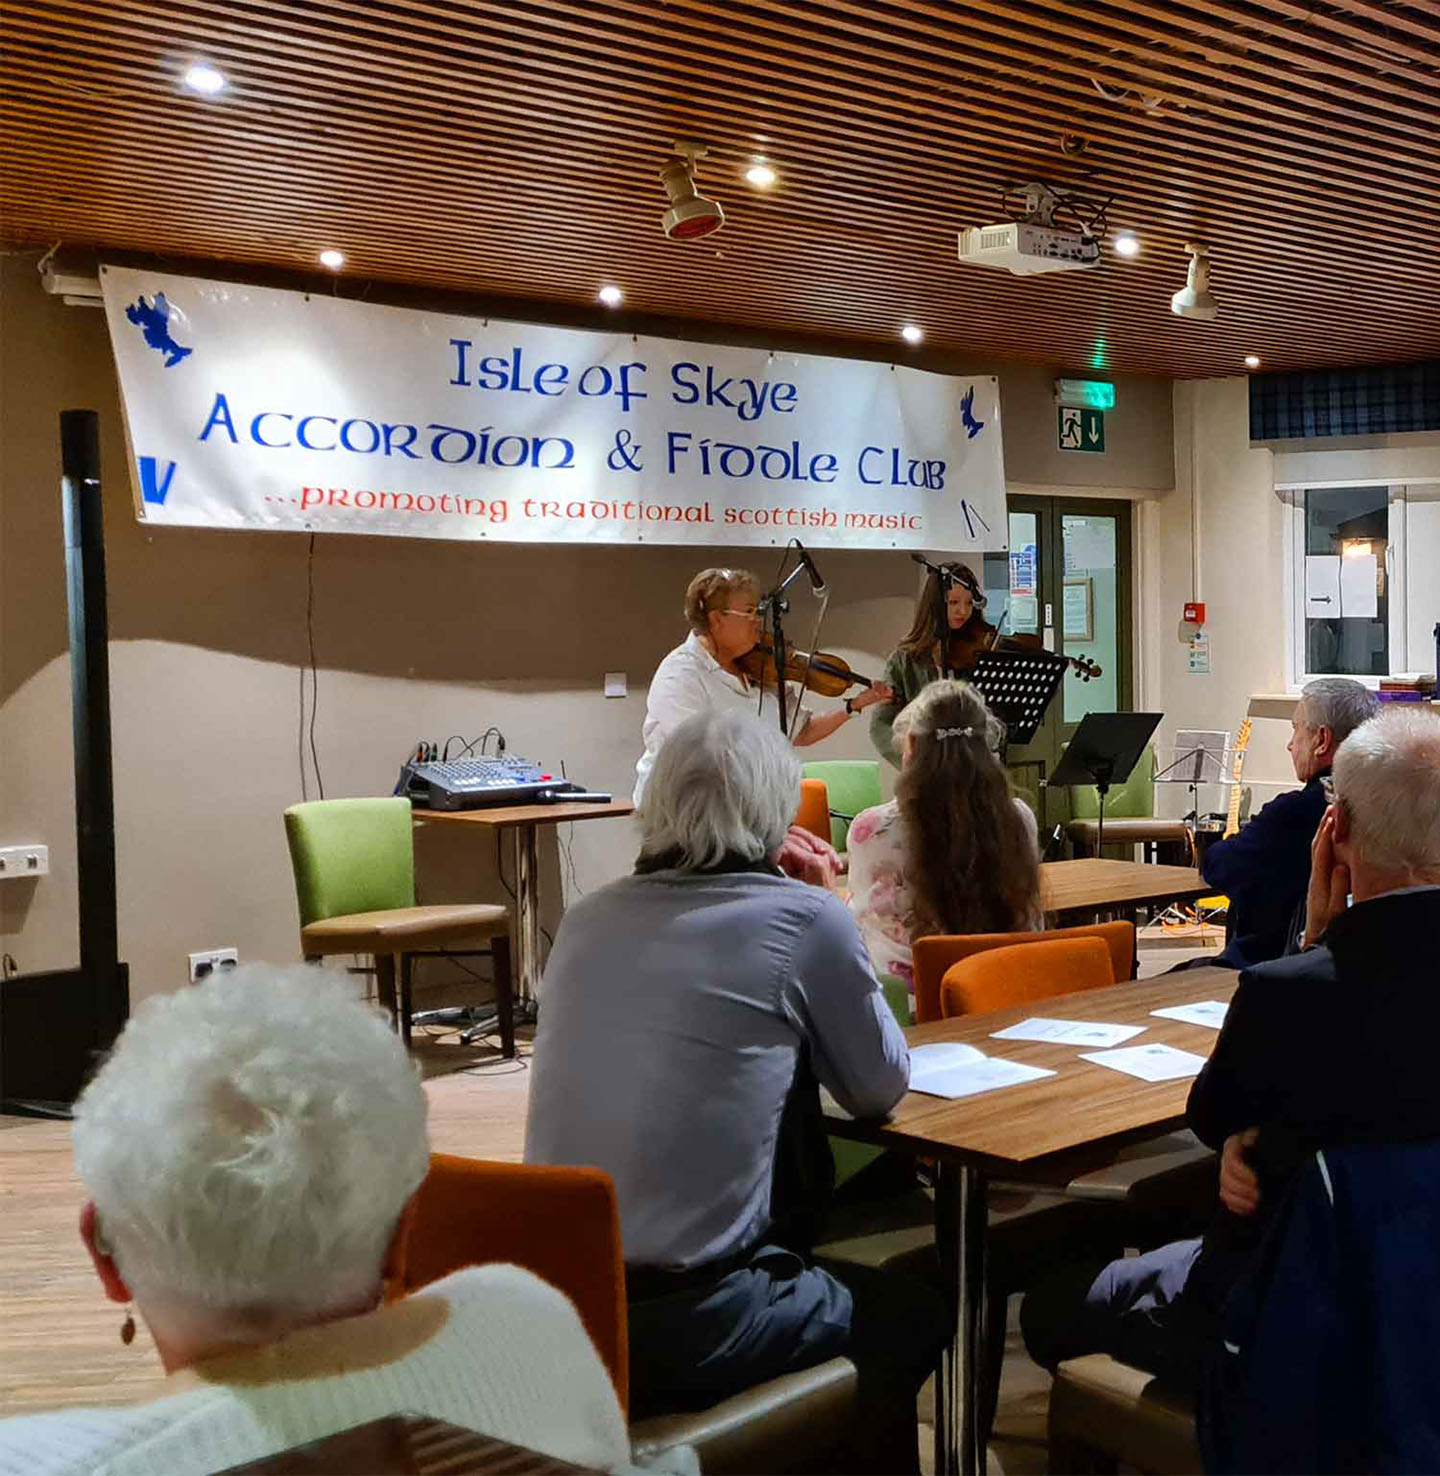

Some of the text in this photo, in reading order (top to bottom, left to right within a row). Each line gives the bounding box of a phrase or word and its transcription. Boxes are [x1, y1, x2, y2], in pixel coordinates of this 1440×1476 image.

[449, 338, 798, 421] Isle of Skye
[607, 429, 643, 472] &
[667, 431, 839, 482] Fiddle
[523, 498, 713, 525] traditional
[724, 507, 838, 528] scottish
[844, 513, 923, 531] music
